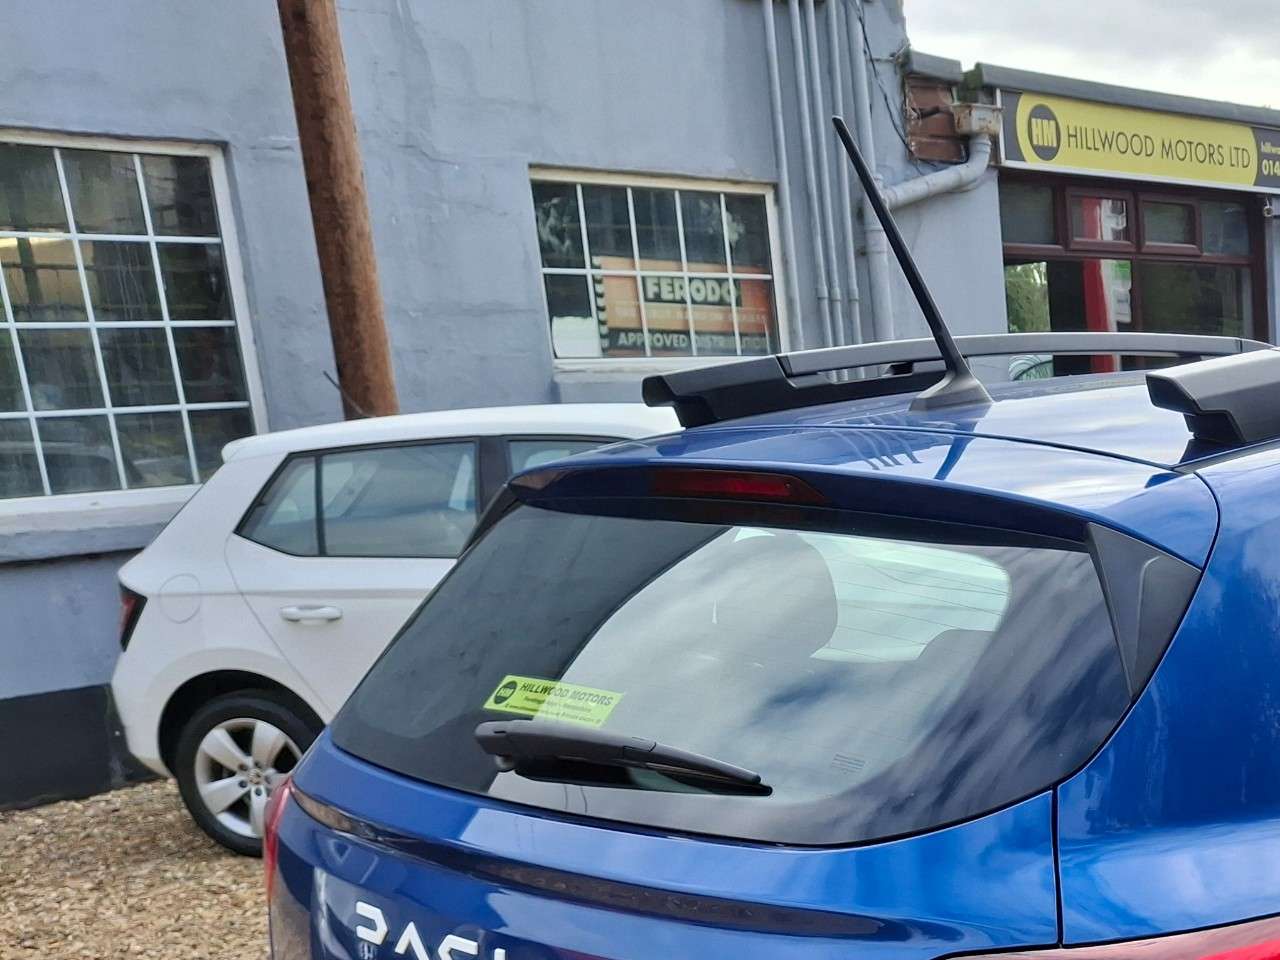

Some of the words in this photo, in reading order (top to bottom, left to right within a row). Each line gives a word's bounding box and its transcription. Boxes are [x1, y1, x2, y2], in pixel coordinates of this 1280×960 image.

[1066, 125, 1155, 157] HILLWOOD
[1161, 136, 1225, 166] MOTORS
[1230, 143, 1251, 169] LTD
[645, 276, 739, 303] FERODO
[519, 681, 570, 699] HILLWOOD
[571, 688, 614, 706] MOTORS
